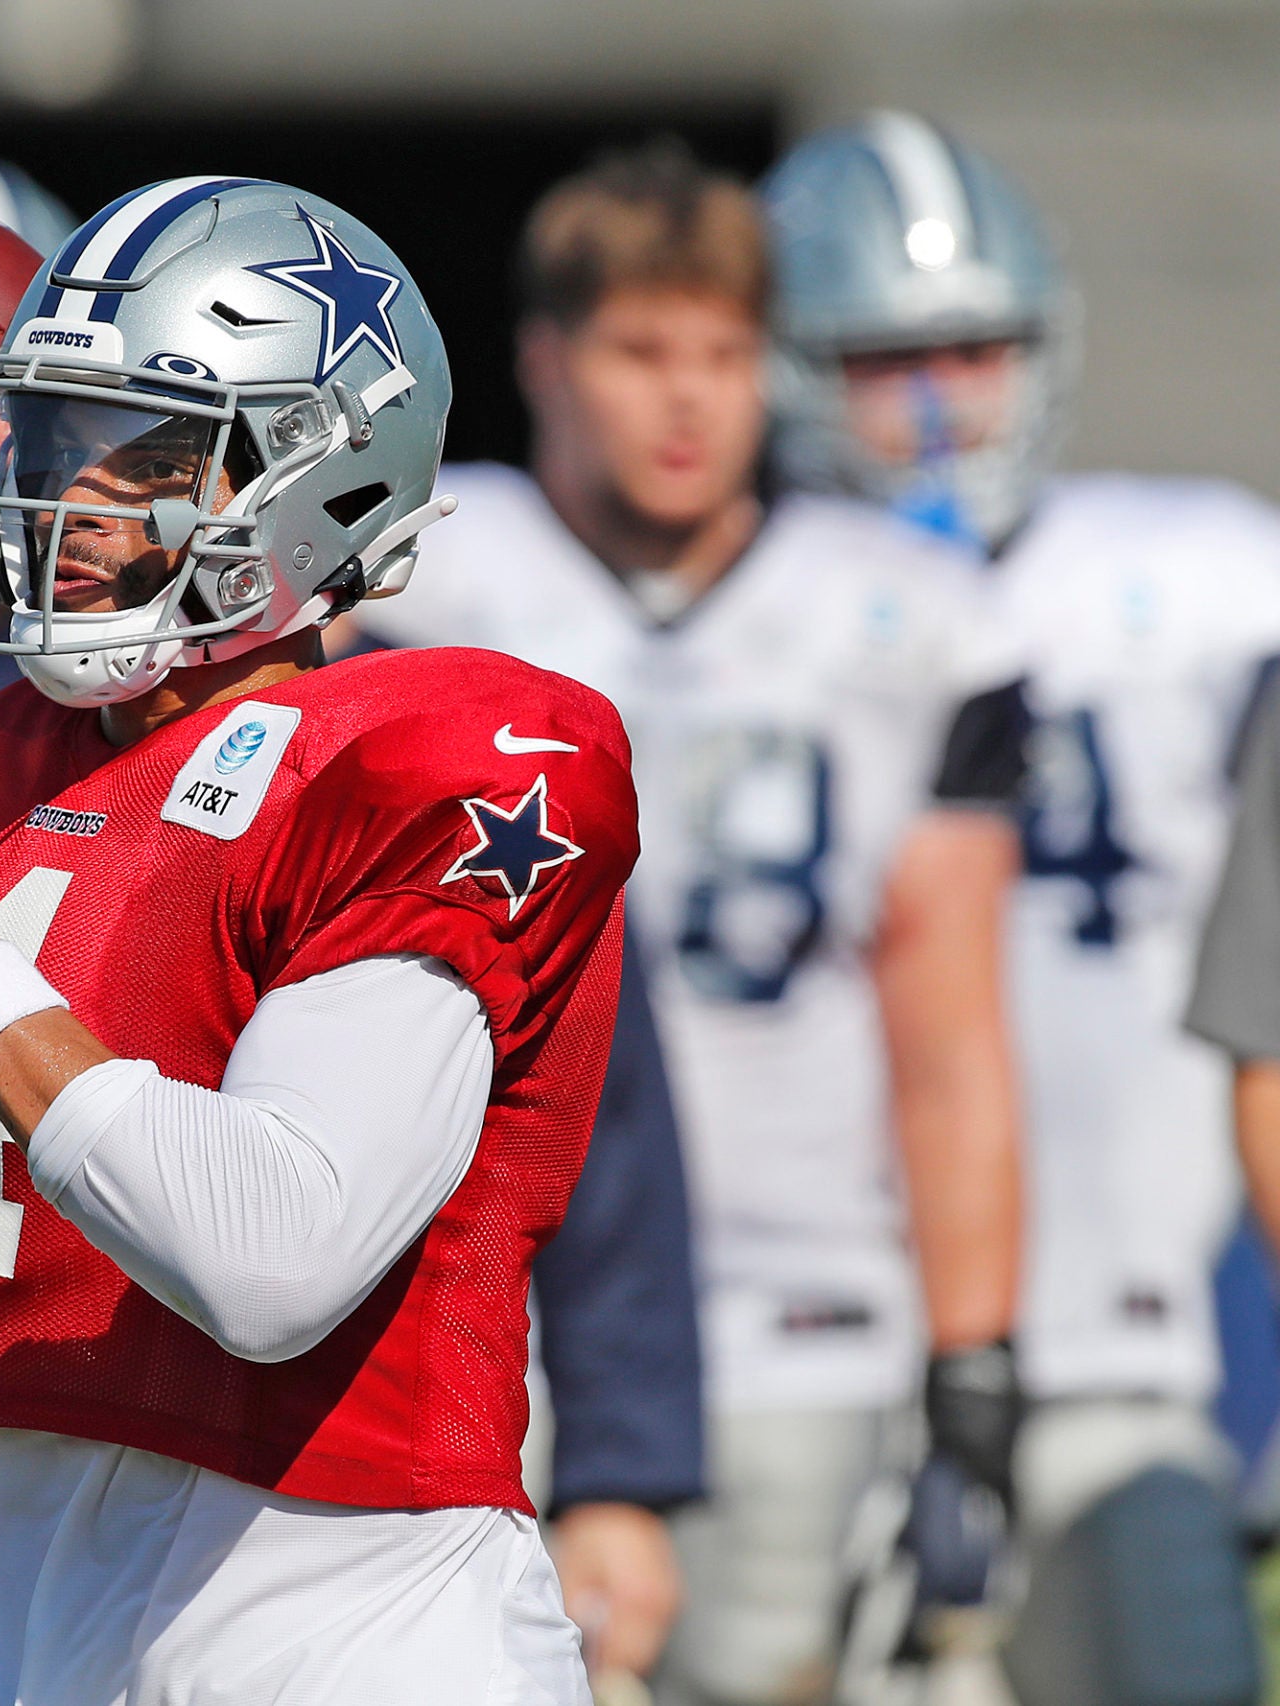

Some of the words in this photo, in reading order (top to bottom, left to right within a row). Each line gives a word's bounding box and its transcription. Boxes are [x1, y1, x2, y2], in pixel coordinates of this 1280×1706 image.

[28, 329, 94, 349] COWBOYS
[179, 780, 239, 816] AT&T
[25, 804, 108, 837] COWBOYS
